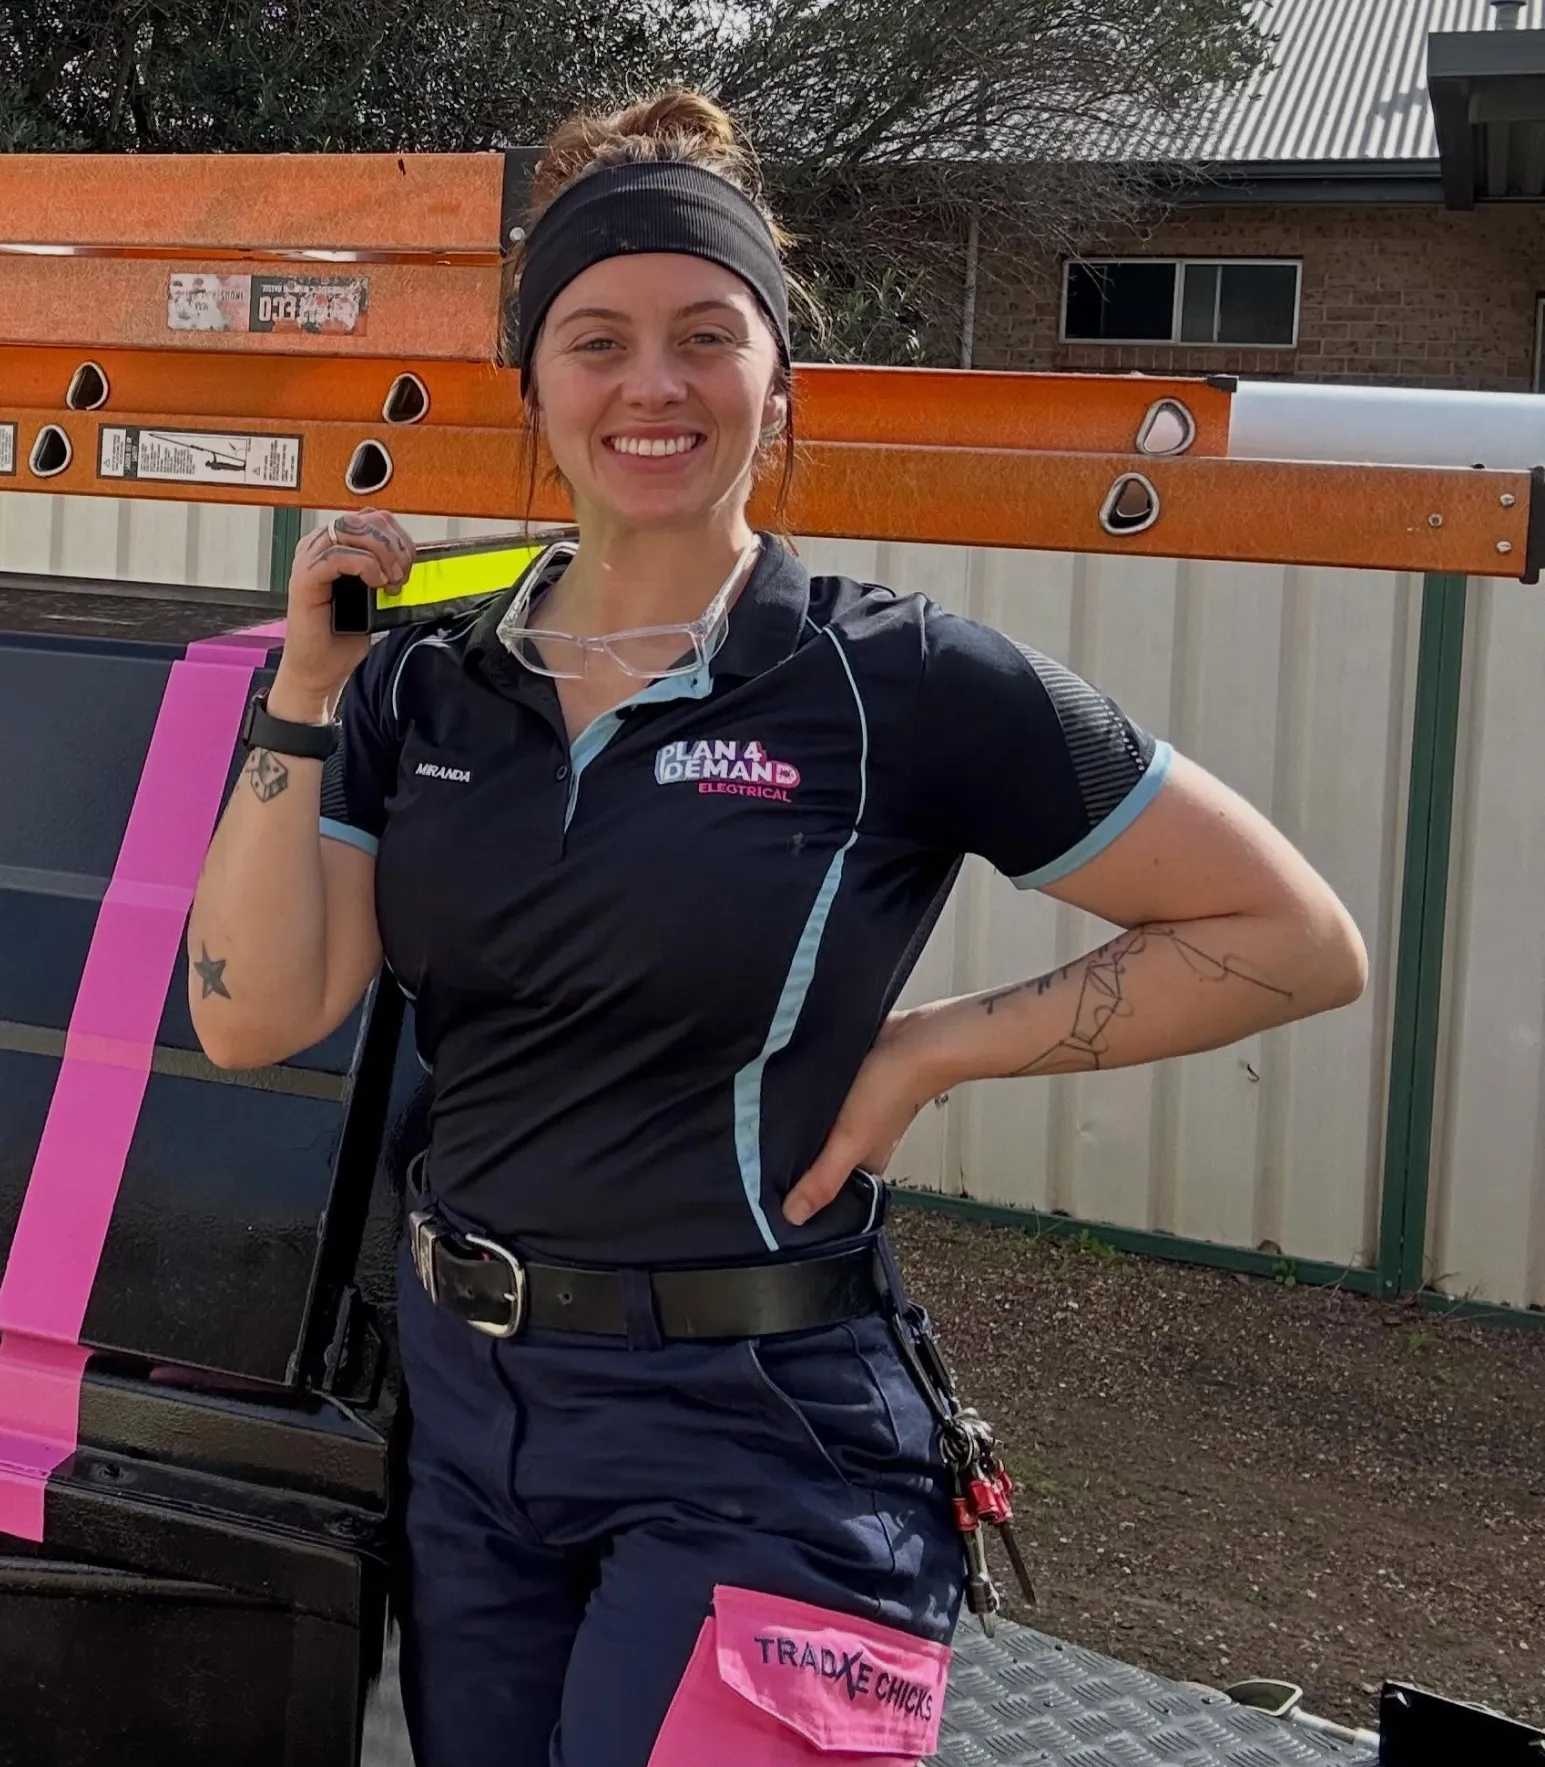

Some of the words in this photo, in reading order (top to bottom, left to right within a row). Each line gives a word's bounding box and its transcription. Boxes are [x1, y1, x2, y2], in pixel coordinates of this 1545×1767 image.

[660, 739, 737, 763] PLAN
[743, 739, 763, 762] 4
[415, 762, 471, 783] MIRANDA
[662, 759, 798, 785] DEMAND
[698, 782, 792, 803] ELECTRICAL
[875, 1671, 934, 1722] CHICKS
